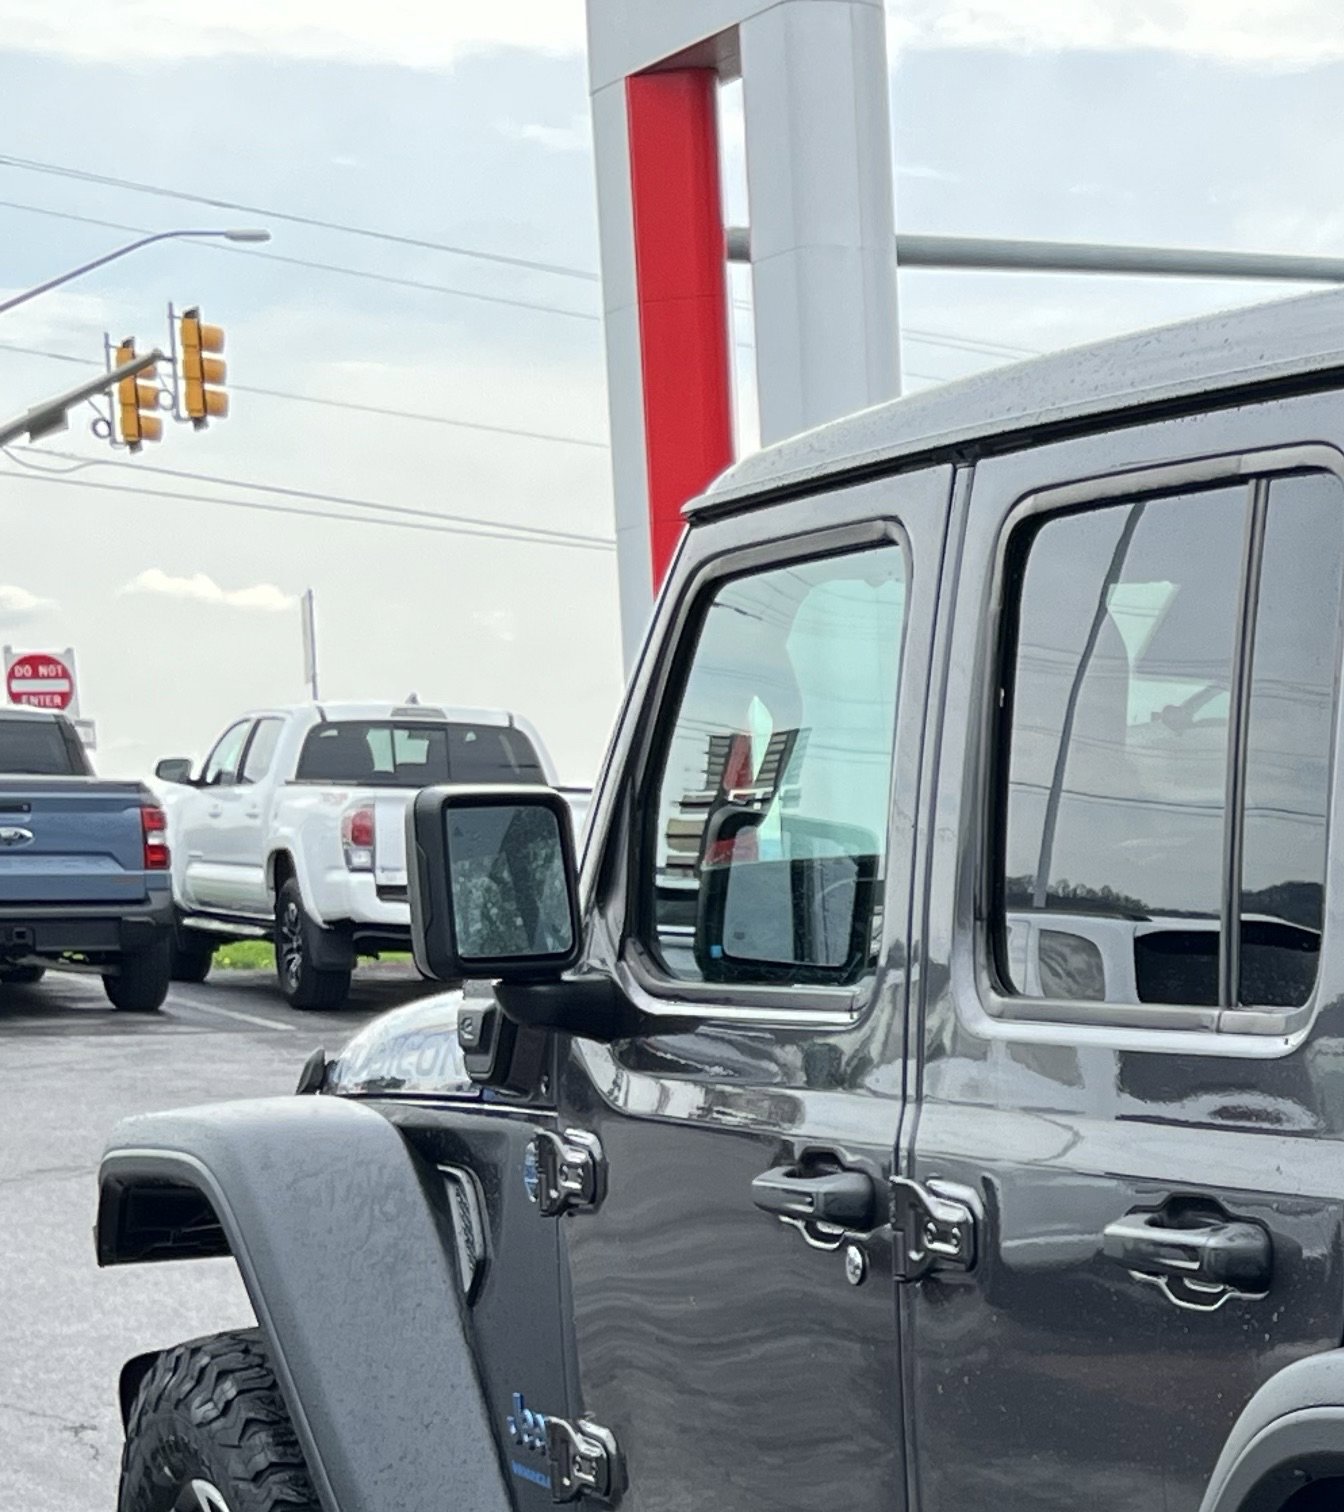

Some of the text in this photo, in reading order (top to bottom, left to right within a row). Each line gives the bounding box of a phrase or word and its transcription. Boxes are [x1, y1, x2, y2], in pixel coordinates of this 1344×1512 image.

[14, 664, 63, 677] DO NOT
[21, 694, 62, 706] ENTER
